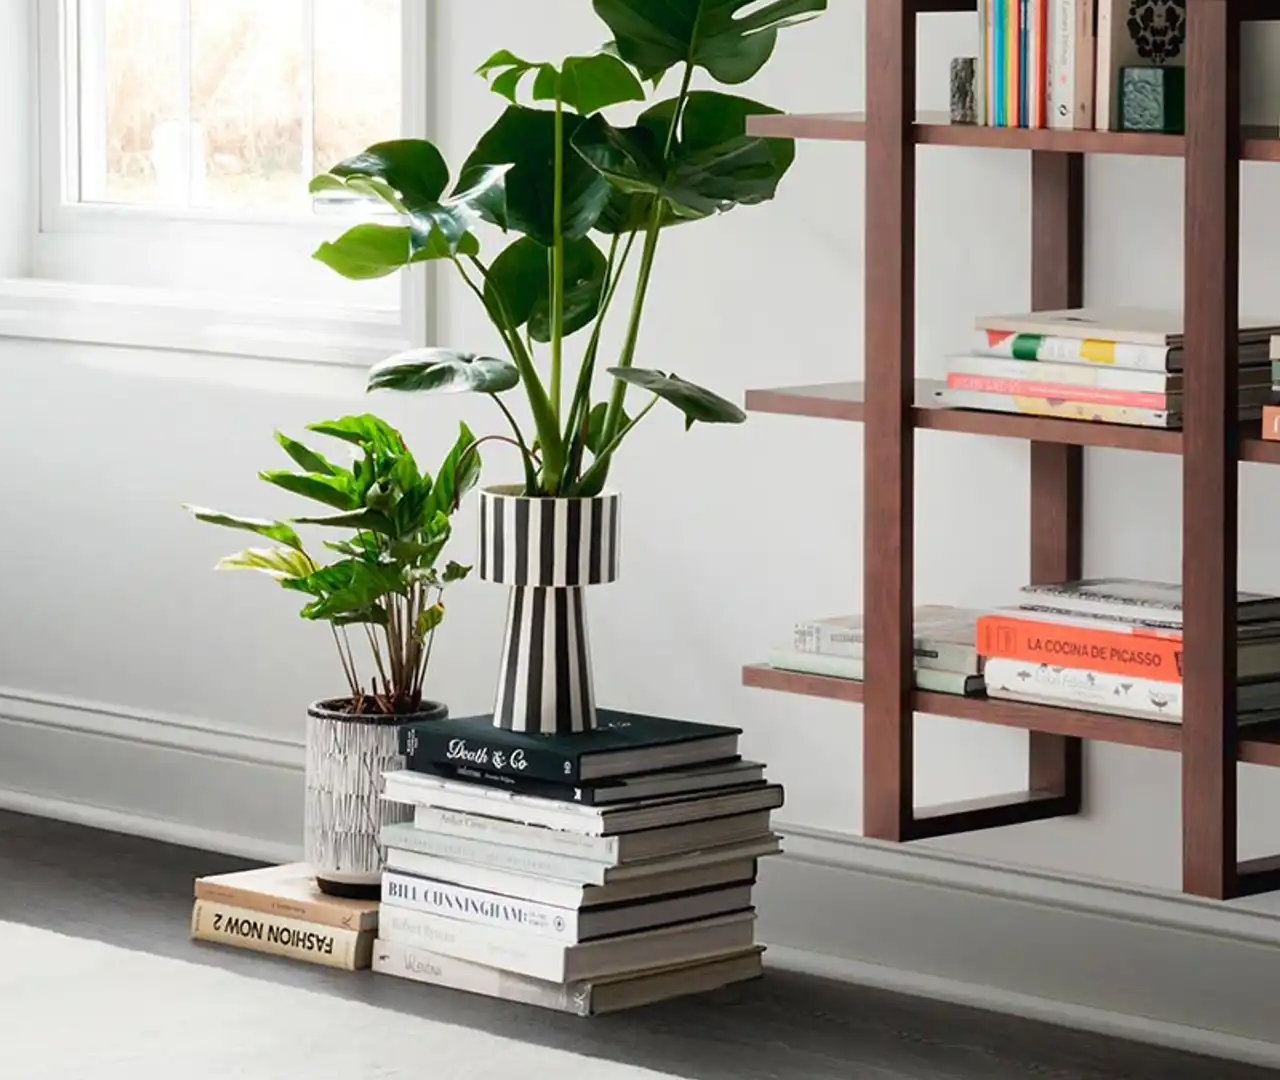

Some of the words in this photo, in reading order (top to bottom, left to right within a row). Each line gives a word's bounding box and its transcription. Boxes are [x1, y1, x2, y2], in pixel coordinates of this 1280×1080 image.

[1027, 637, 1043, 652] LA
[1045, 640, 1089, 659] COCINA
[1091, 645, 1109, 661] DE
[1109, 648, 1162, 667] PICASSO
[445, 738, 488, 766] Death
[492, 751, 507, 769] &
[509, 749, 529, 770] Co
[387, 881, 419, 903] BILL
[213, 913, 224, 931] 2
[224, 916, 264, 939] NOW
[267, 925, 334, 954] FASHION
